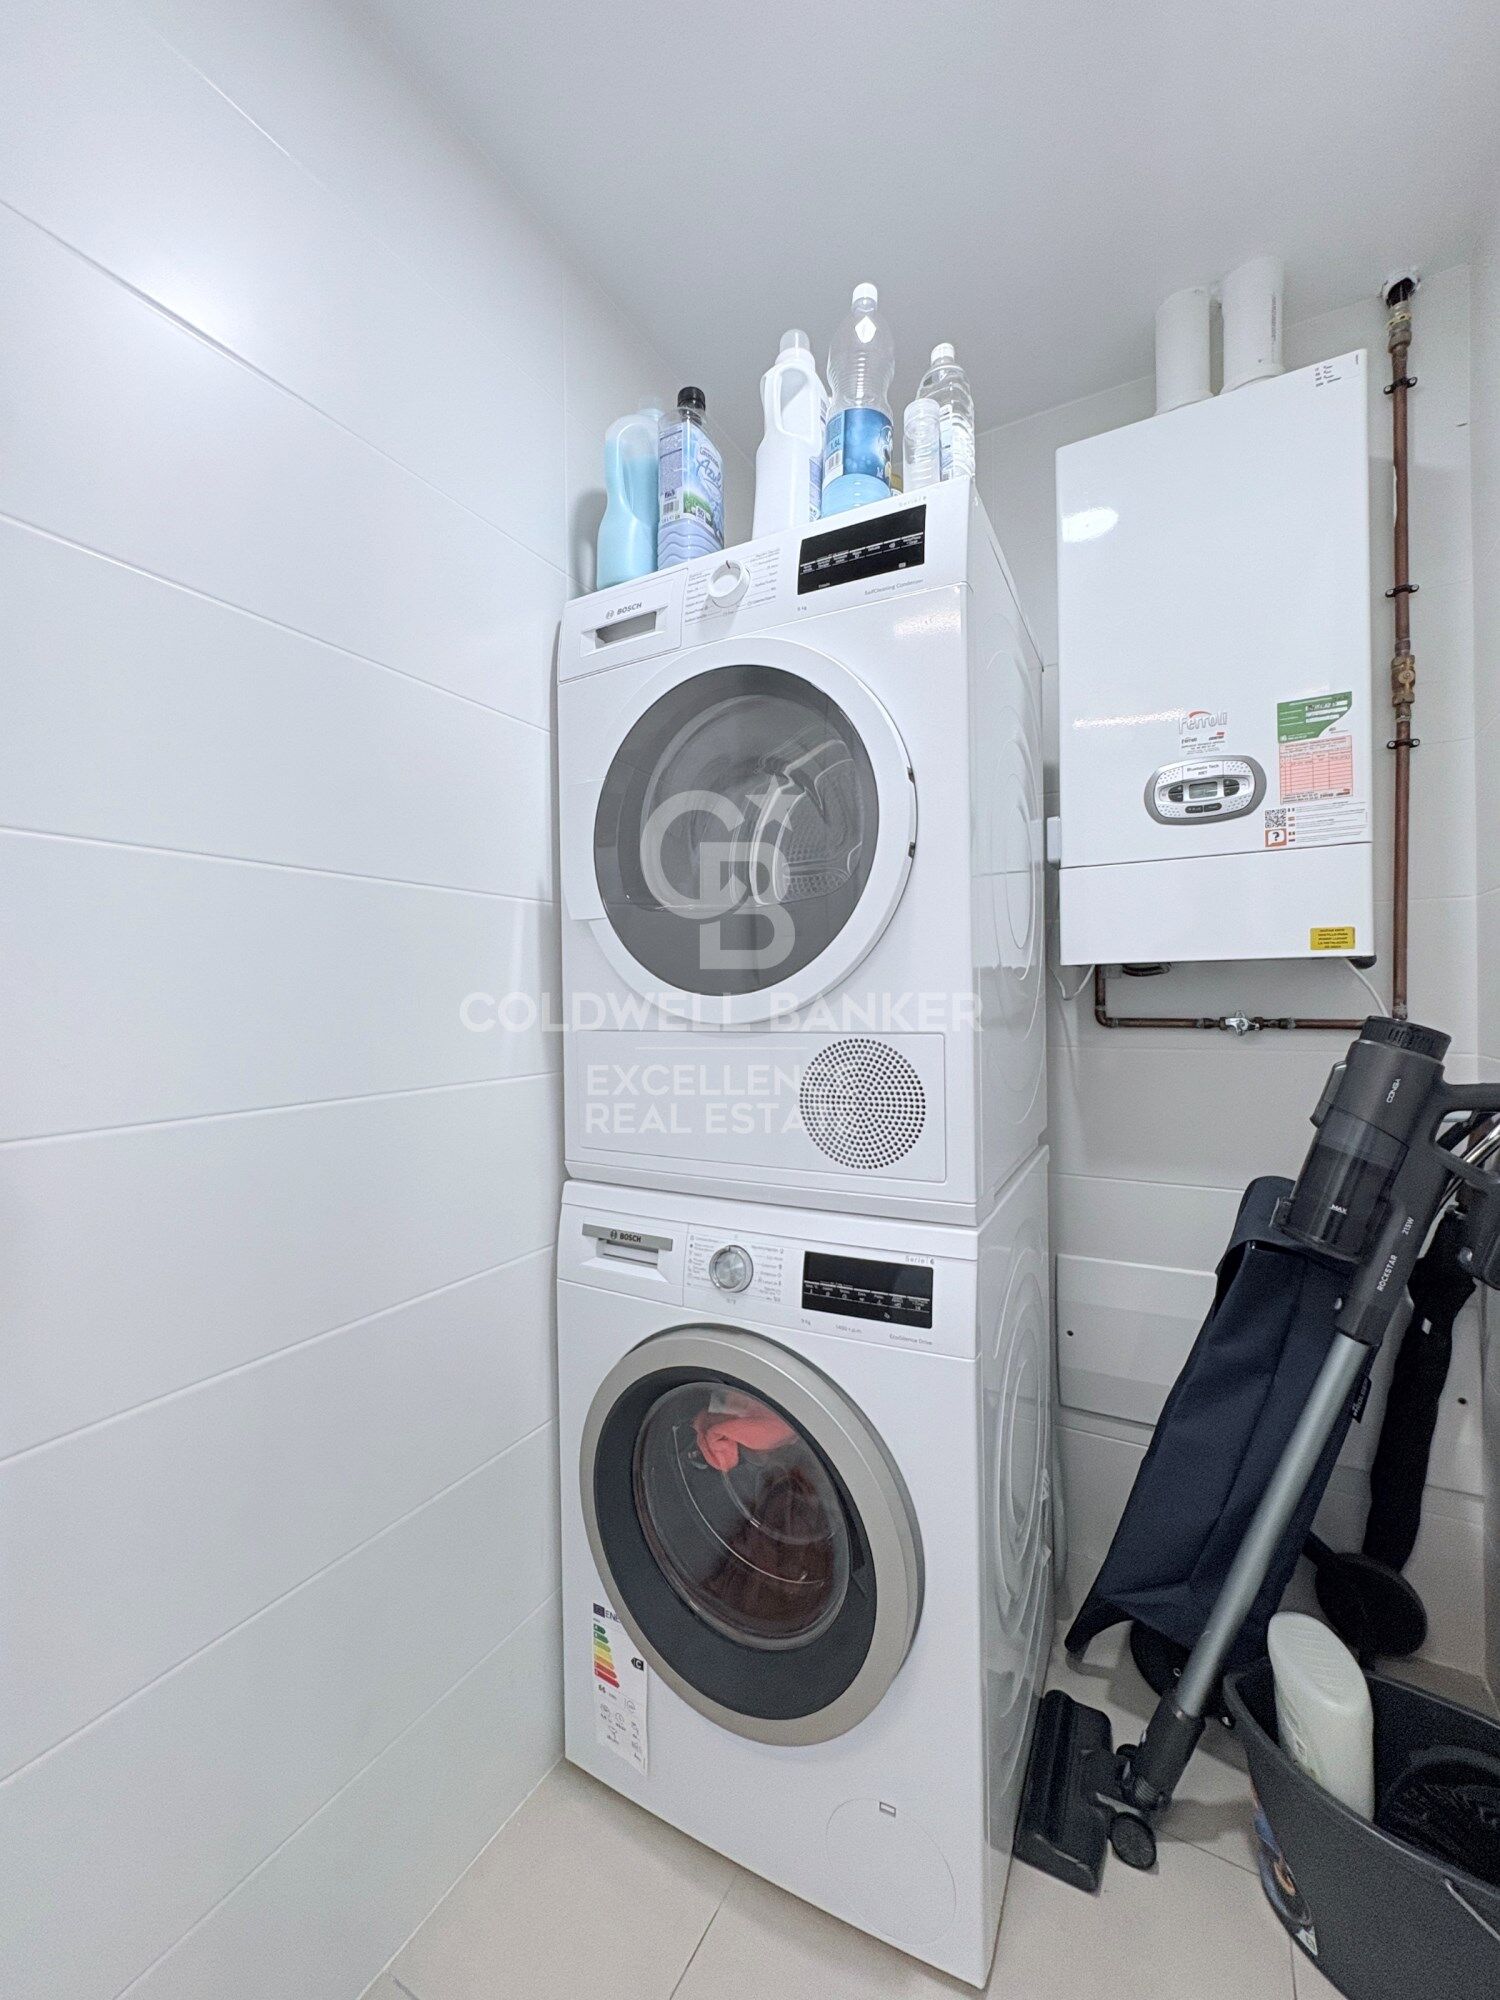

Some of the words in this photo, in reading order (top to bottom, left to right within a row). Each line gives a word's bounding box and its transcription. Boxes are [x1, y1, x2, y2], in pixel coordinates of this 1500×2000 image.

[616, 602, 643, 615] BOSCH
[1331, 1204, 1348, 1215] MAX
[619, 1232, 642, 1243] BOSCH
[1376, 1254, 1398, 1292] ROCKSTAR
